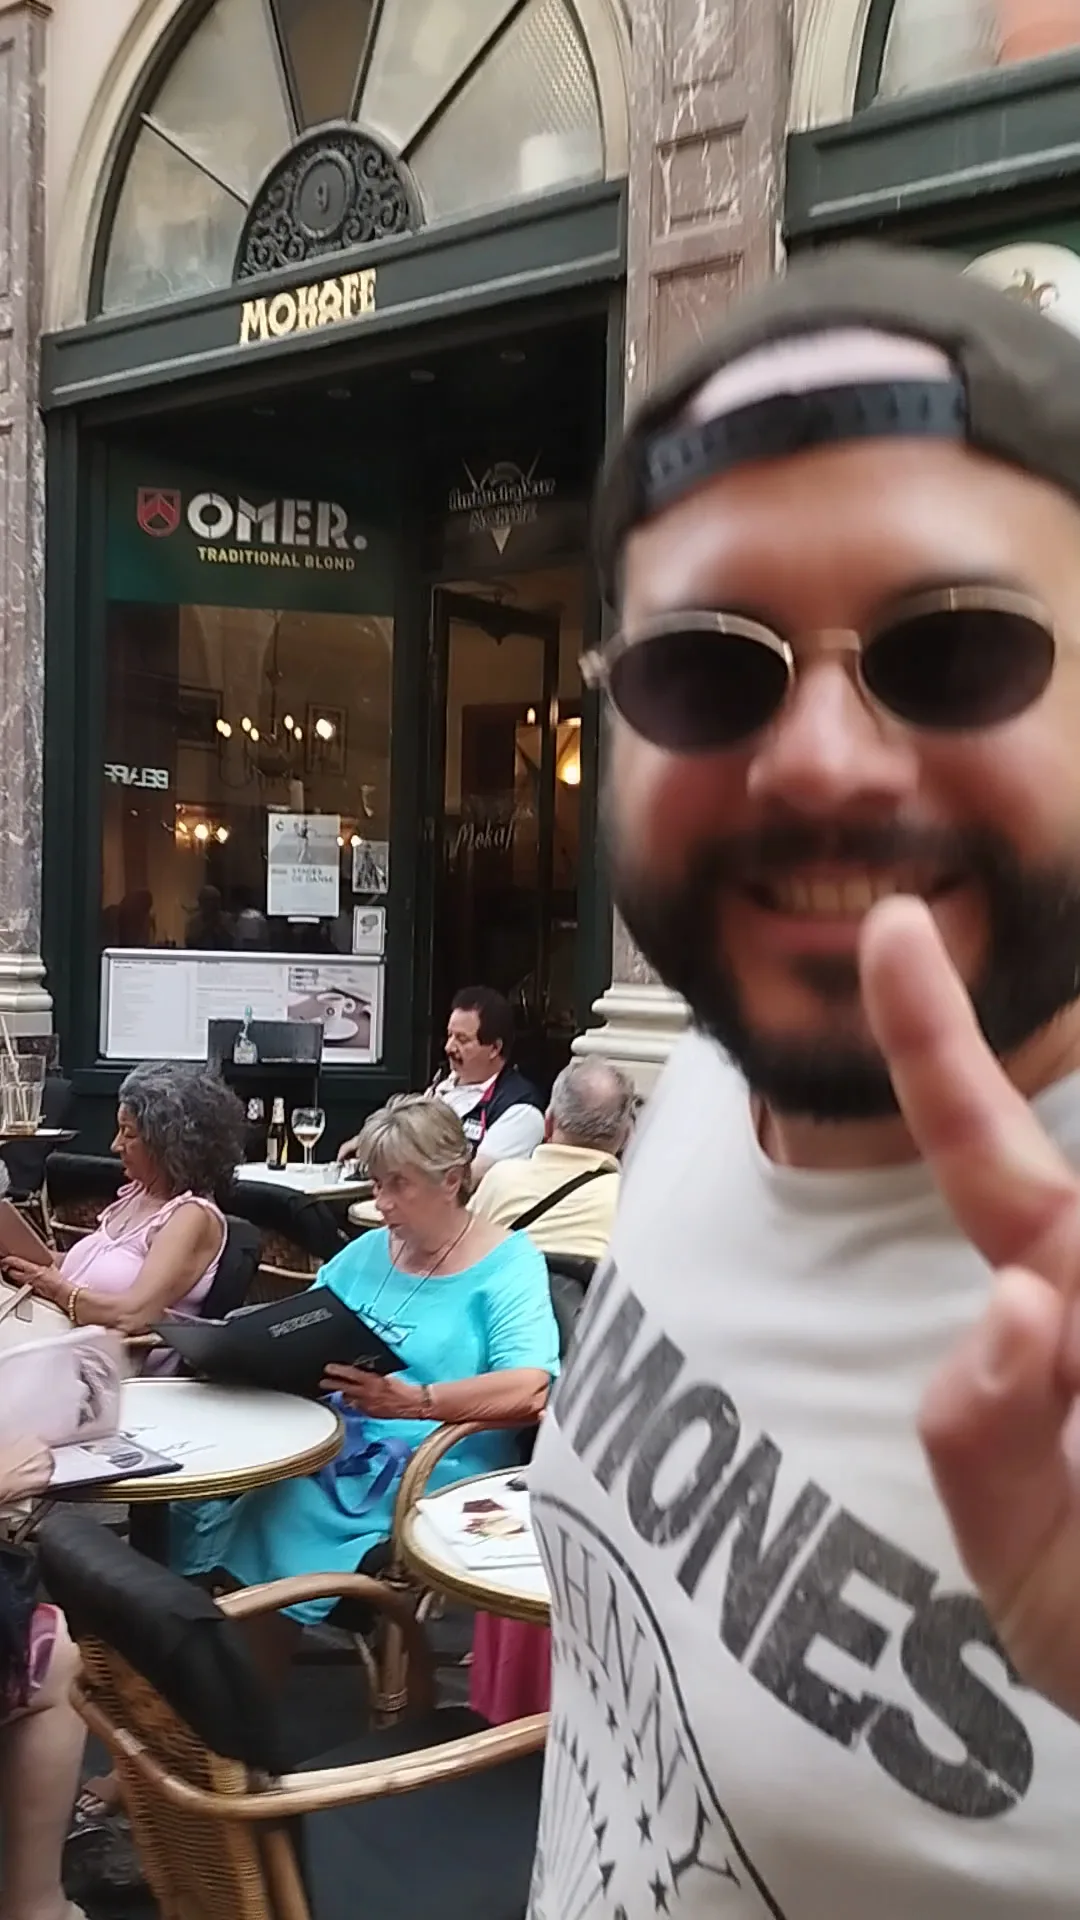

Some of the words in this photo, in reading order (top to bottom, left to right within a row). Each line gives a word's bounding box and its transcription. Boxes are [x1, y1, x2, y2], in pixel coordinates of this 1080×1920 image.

[197, 546, 301, 568] TRADITIONAL
[304, 553, 355, 571] BLOND
[553, 1258, 1035, 1820] MONES
